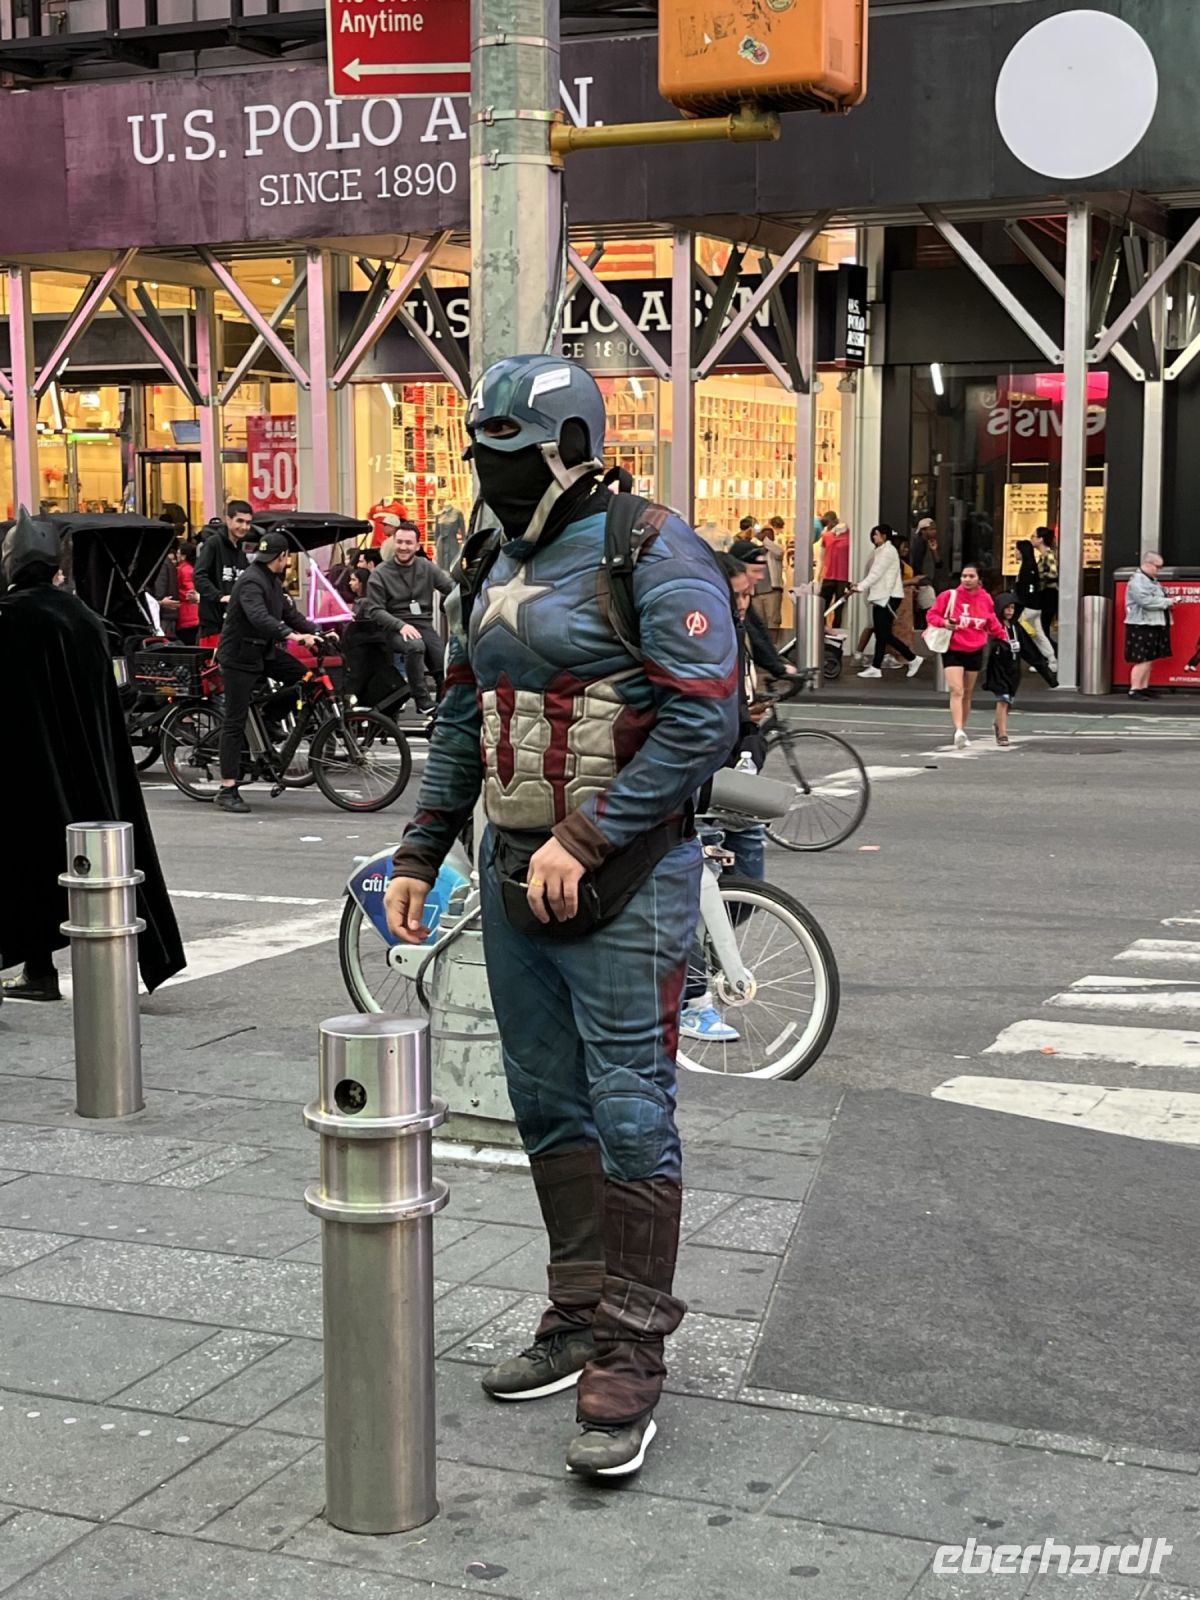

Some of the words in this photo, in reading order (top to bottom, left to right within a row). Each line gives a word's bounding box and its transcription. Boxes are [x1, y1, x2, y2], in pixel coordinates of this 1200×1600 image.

[340, 9, 424, 39] Anytime
[127, 109, 227, 165] U.S.
[244, 97, 402, 157] POLO
[259, 168, 362, 206] SINCE
[374, 161, 457, 198] 1890
[252, 450, 298, 500] 50
